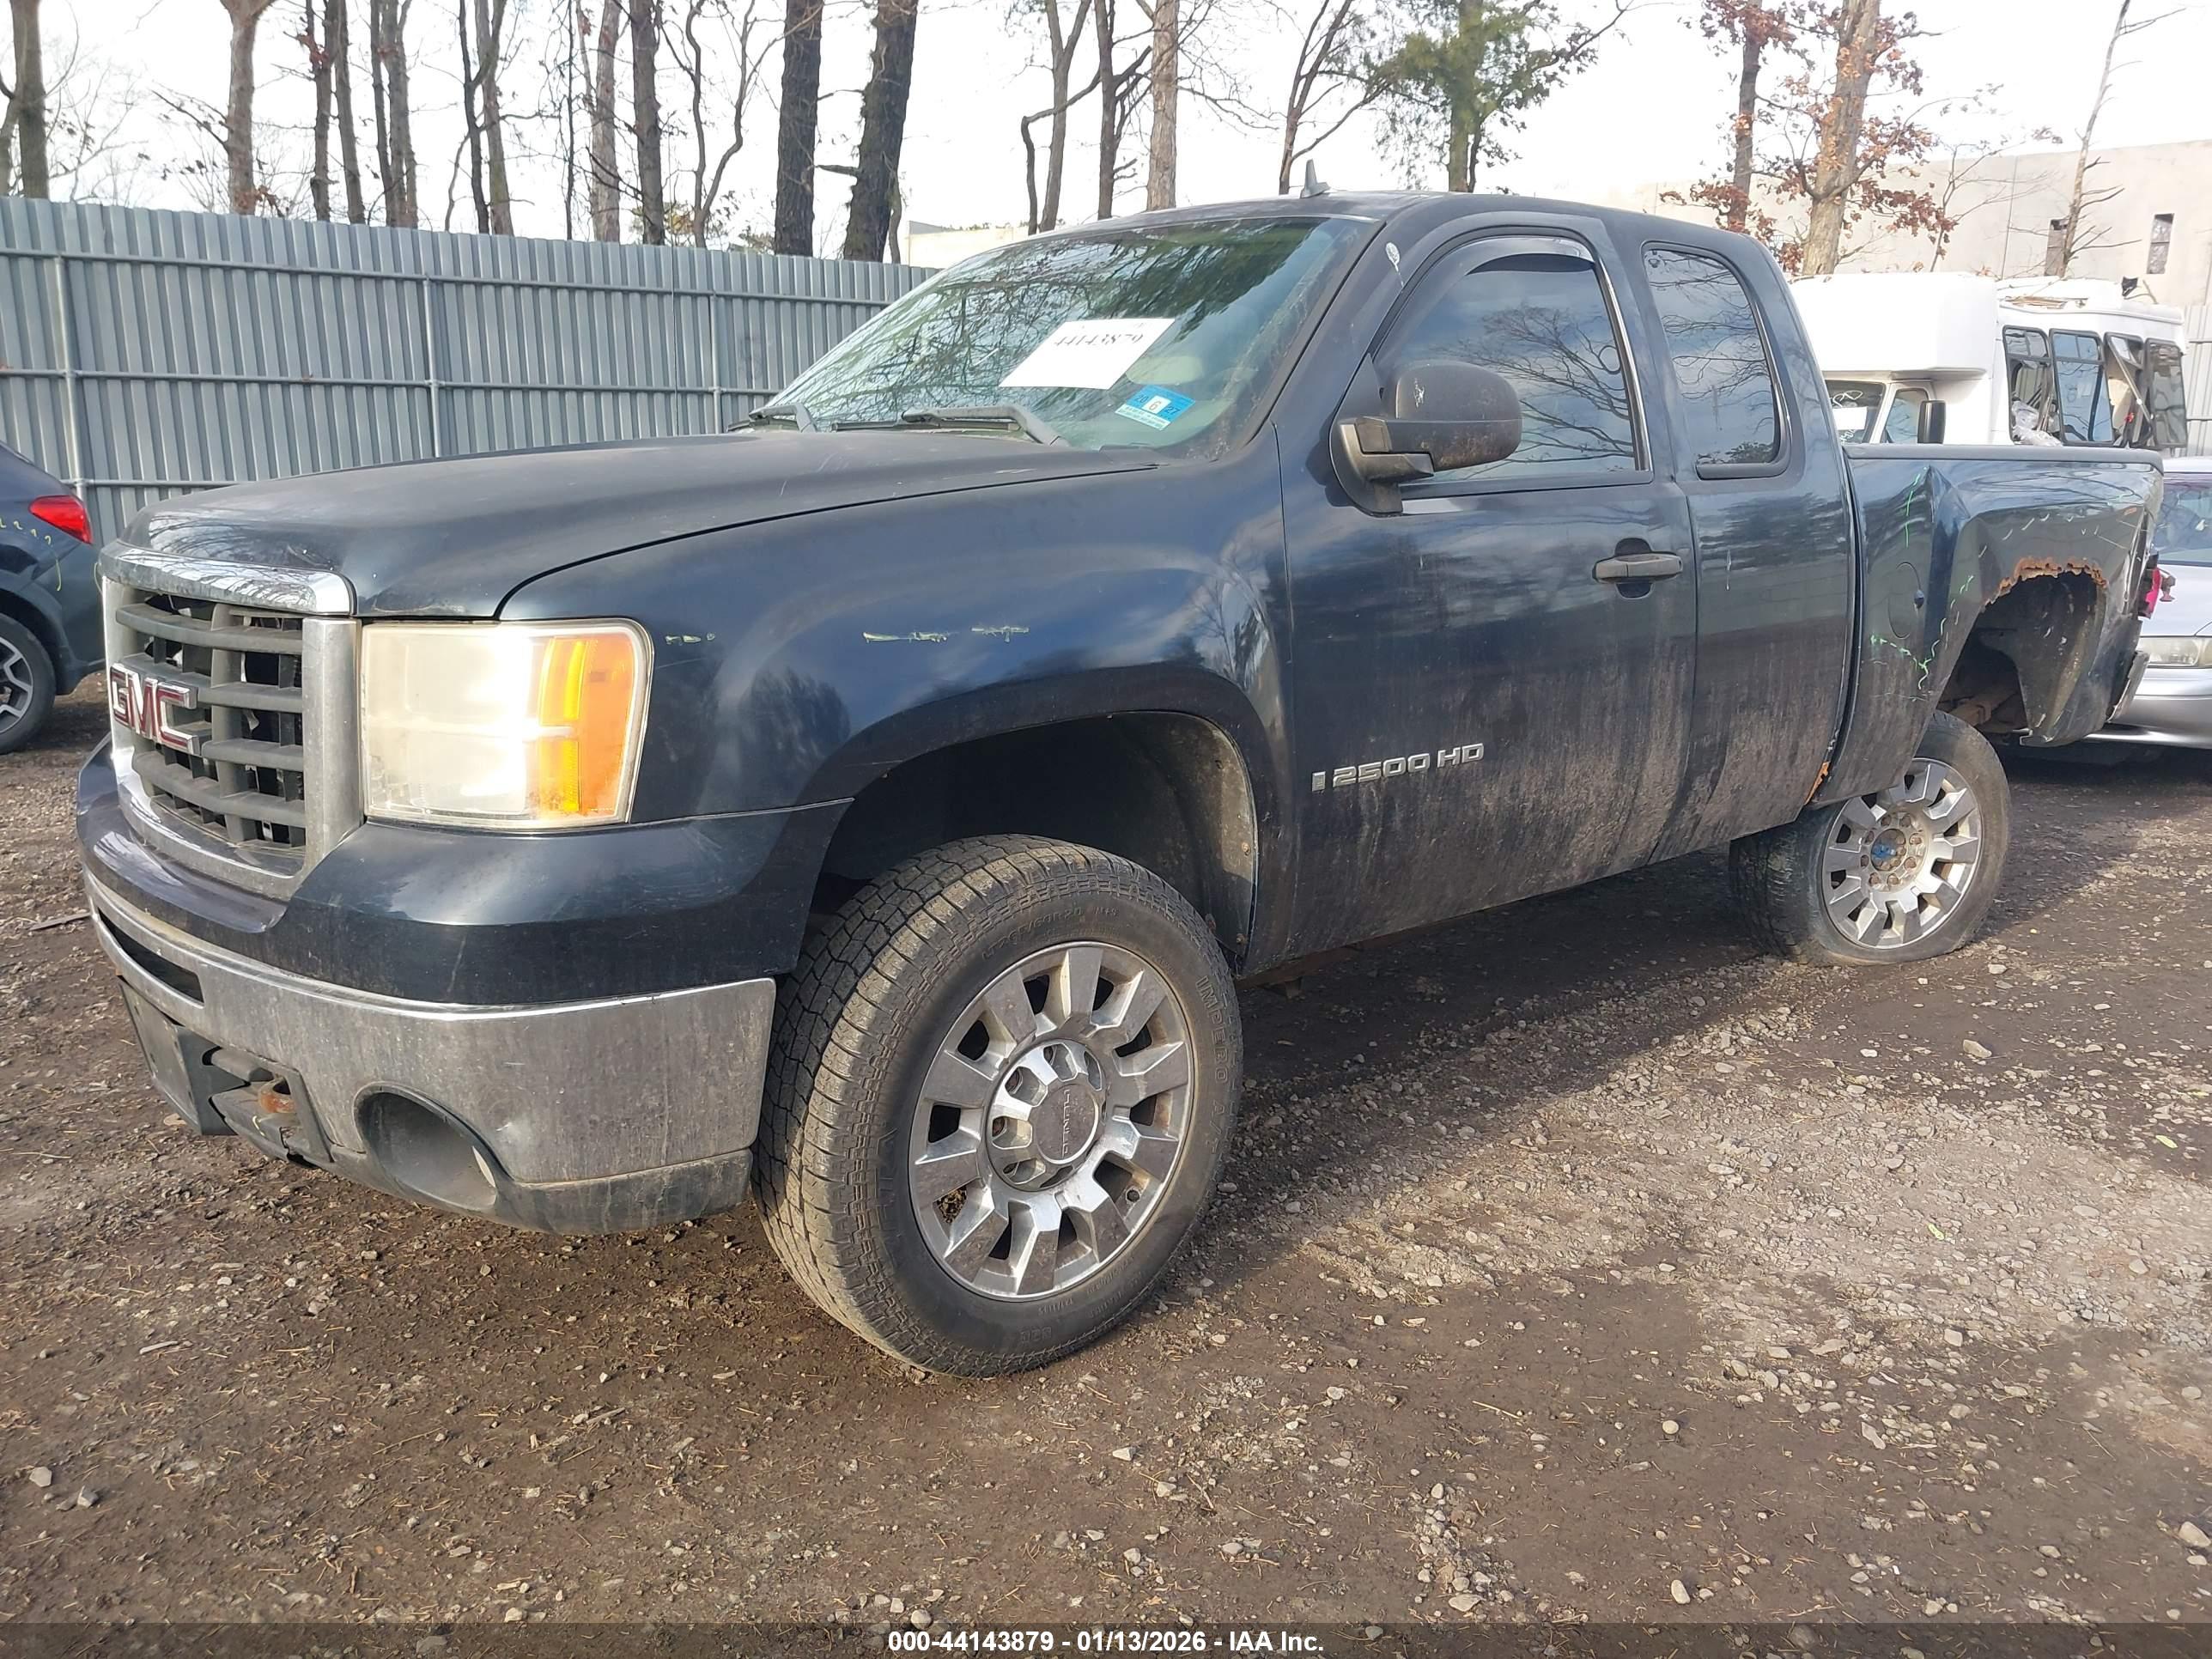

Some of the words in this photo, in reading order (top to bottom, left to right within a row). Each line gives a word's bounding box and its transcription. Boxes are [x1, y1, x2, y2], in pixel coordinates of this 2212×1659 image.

[1148, 400, 1162, 411] 6
[110, 662, 201, 757] GMC
[1332, 752, 1431, 787] 2500
[1437, 743, 1485, 768] HD
